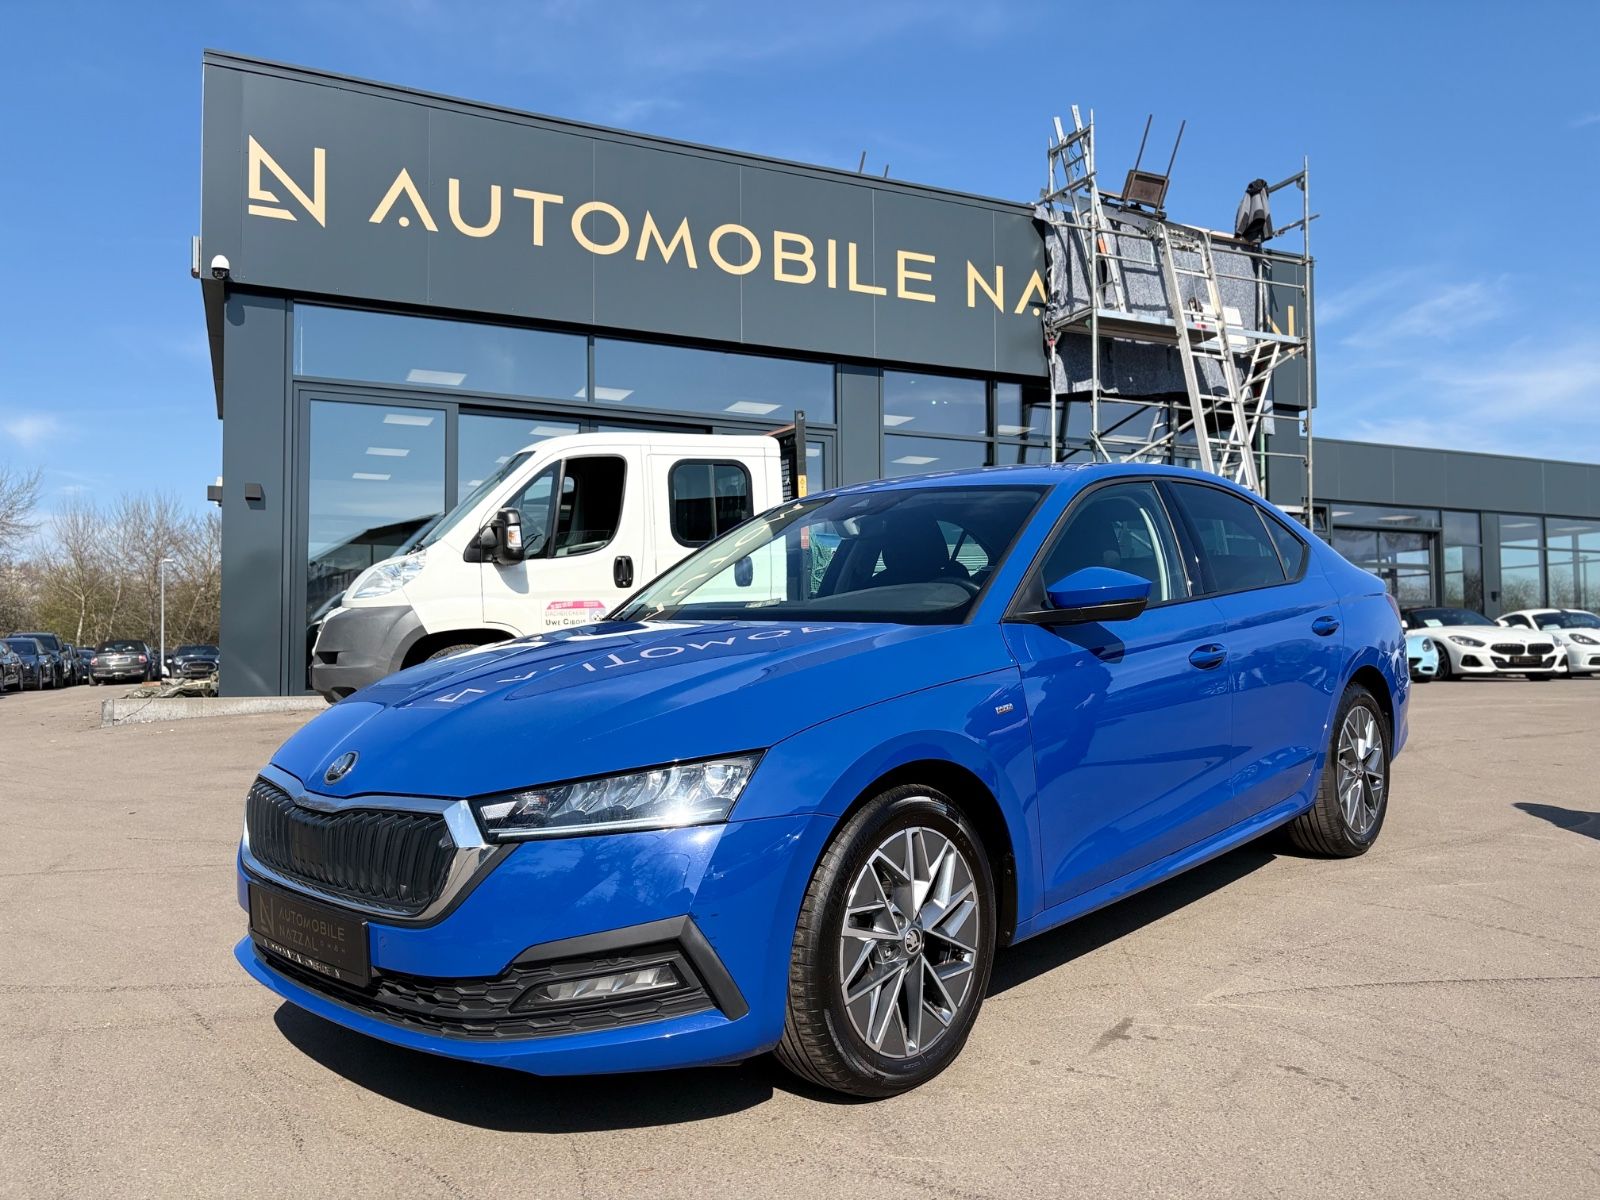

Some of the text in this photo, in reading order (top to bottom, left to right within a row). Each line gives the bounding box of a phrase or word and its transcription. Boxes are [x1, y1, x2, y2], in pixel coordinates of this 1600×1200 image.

[369, 167, 936, 304] AUTOMOBILE
[278, 906, 345, 942] AUTOMOBILE
[279, 925, 319, 952] NAZZAL
